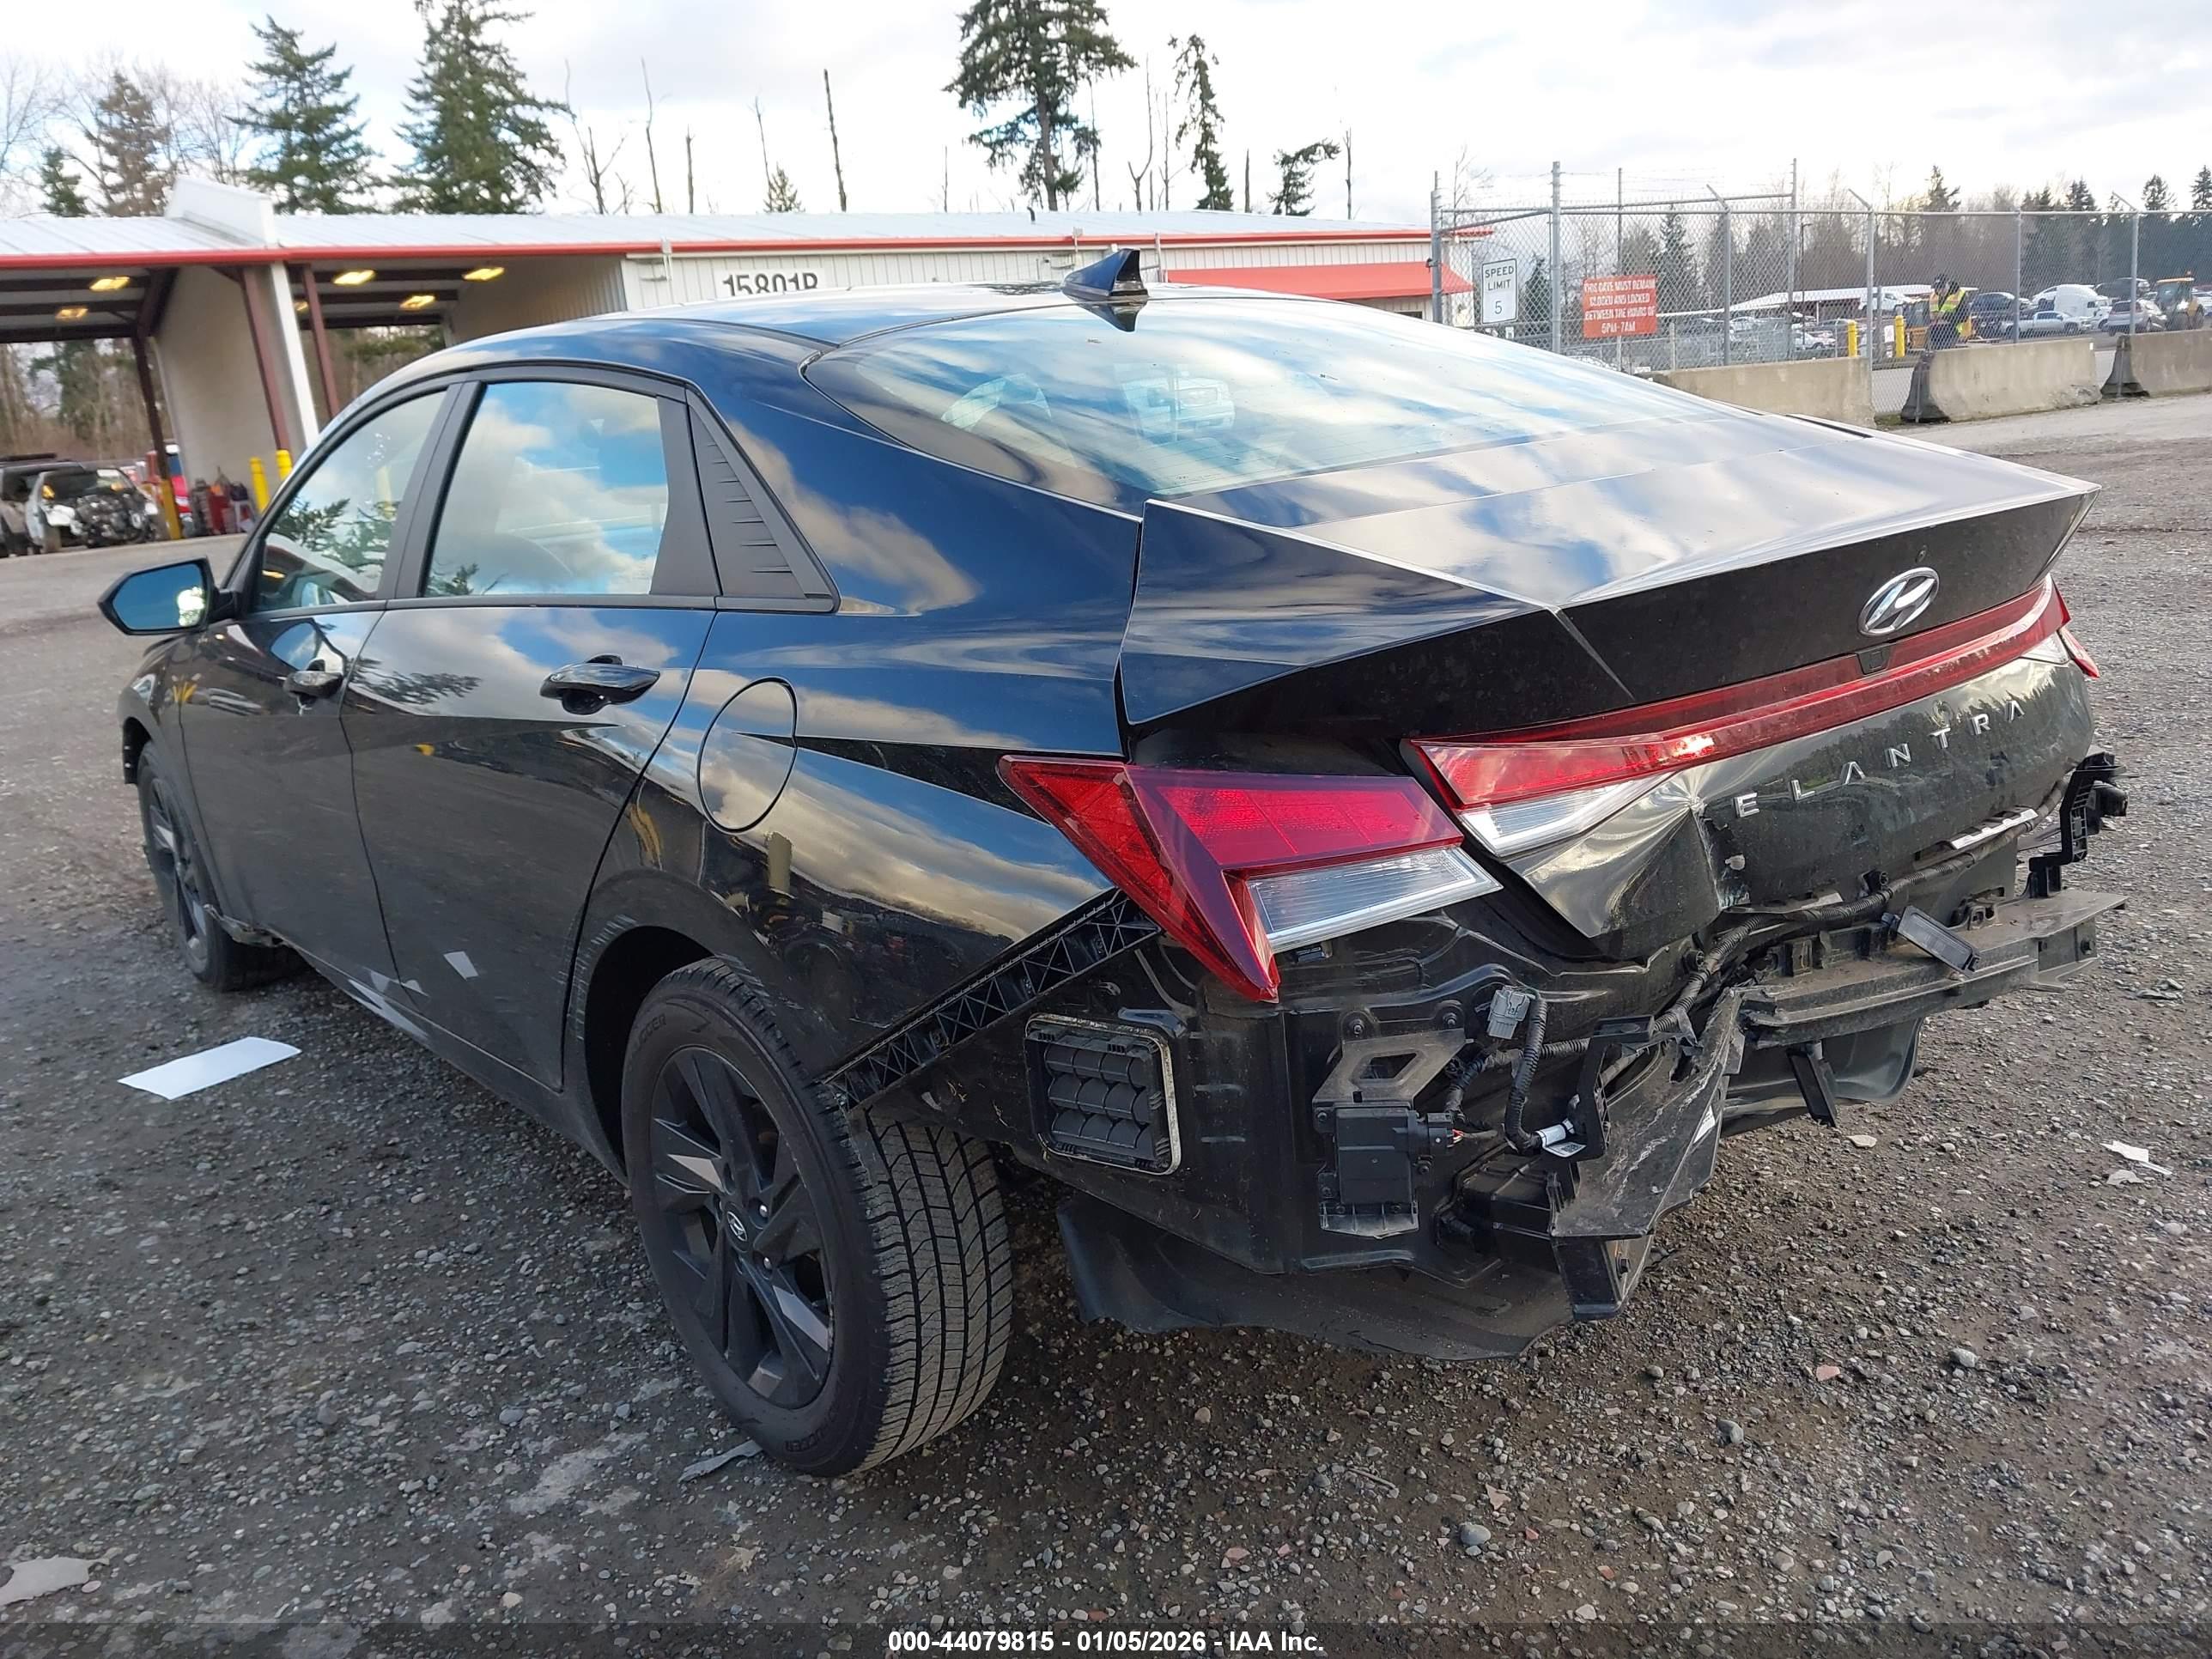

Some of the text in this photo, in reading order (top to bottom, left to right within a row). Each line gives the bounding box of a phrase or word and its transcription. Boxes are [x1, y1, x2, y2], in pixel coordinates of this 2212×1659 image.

[1485, 265, 1514, 278] SPEED
[1487, 279, 1511, 291] LIMIT
[1583, 278, 1656, 293] THIS GATE MUST REMAIN
[1494, 300, 1503, 314] 5
[1589, 292, 1650, 307] CLOSED AND LOCKED
[1584, 306, 1656, 321] BETWEEN THE HOURS OF
[1733, 700, 2025, 818] ELANTRA
